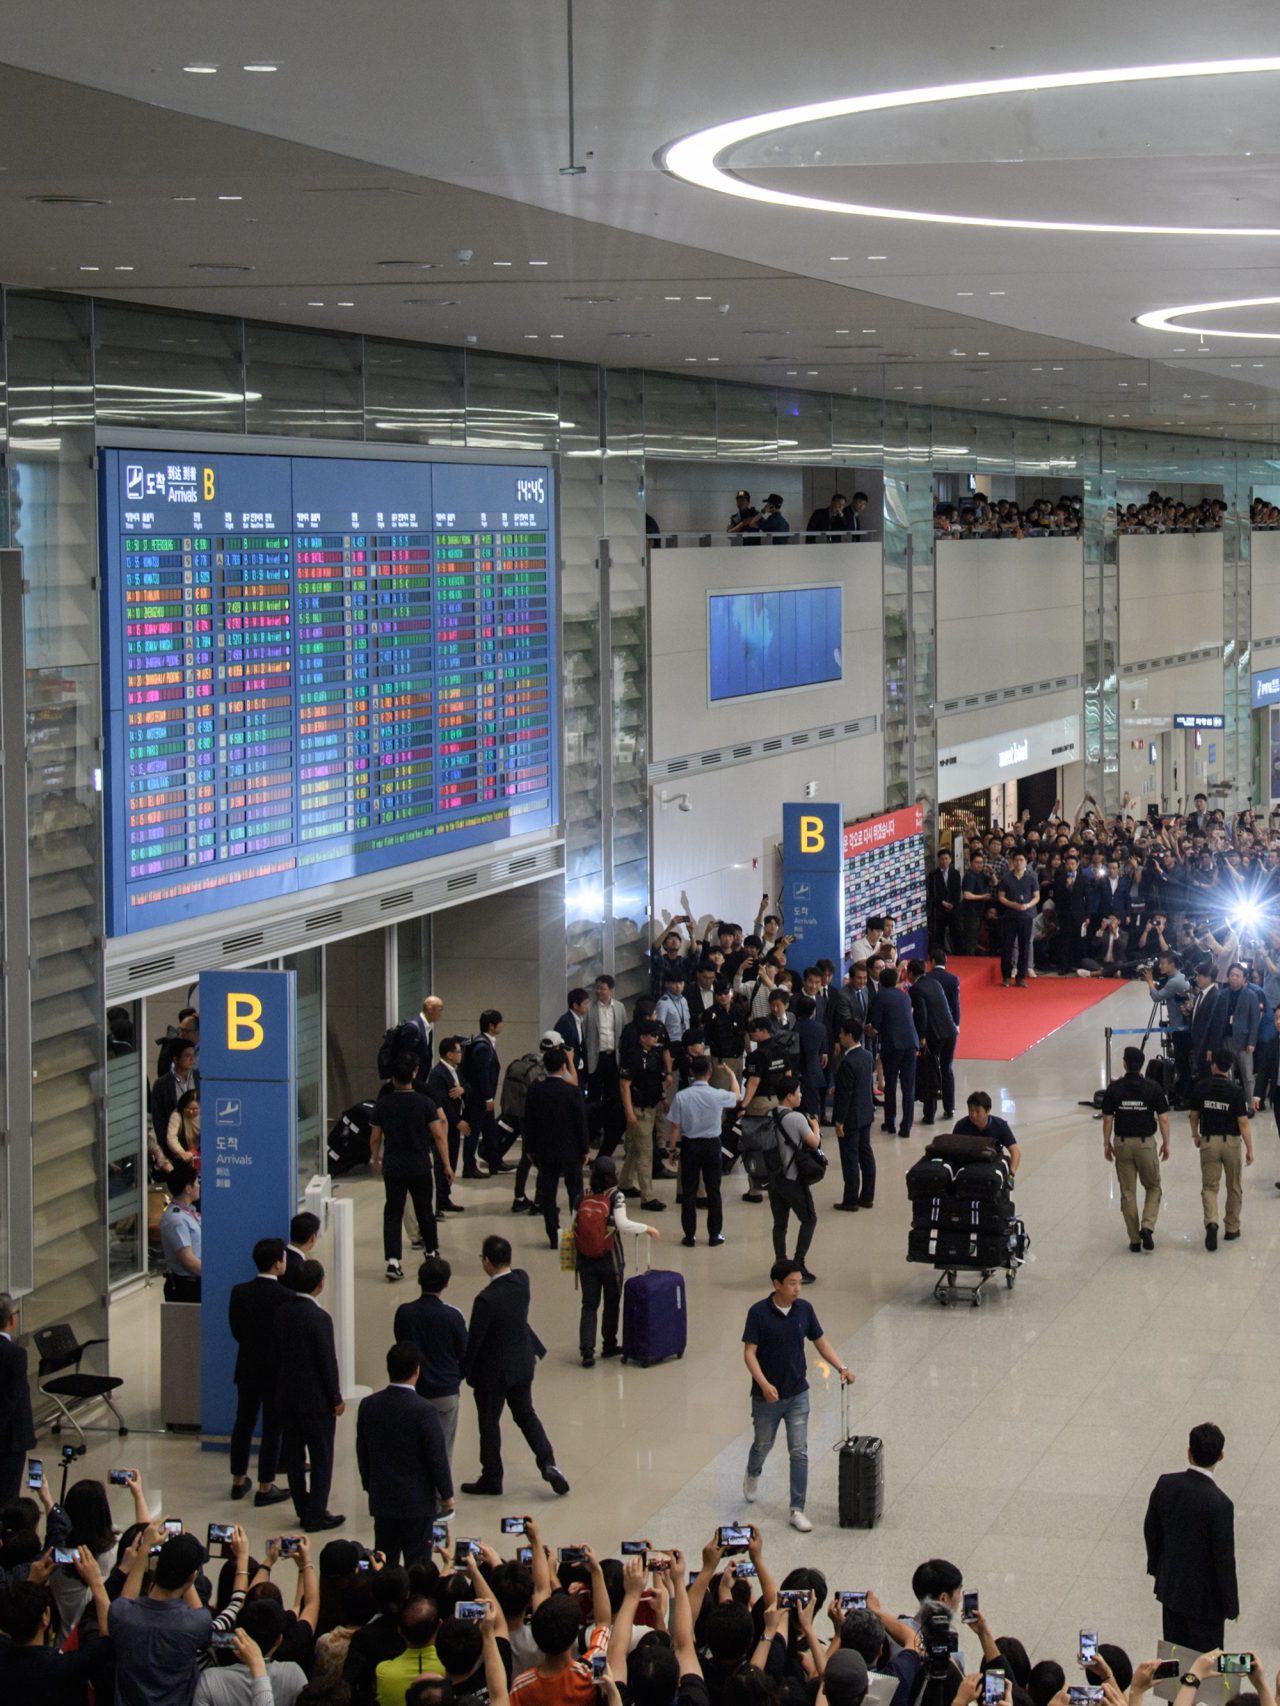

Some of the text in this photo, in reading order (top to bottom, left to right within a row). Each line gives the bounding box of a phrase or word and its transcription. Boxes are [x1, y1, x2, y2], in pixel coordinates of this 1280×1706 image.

[146, 471, 166, 496] 도착
[203, 468, 215, 501] B
[517, 477, 545, 504] 14:45
[168, 486, 198, 503] Arrivals
[800, 815, 825, 854] B
[794, 917, 818, 925] Arrivals
[227, 992, 264, 1051] B
[1203, 1099, 1230, 1112] SECURITY
[216, 1136, 239, 1151] 도착
[216, 1154, 253, 1165] Arrivals
